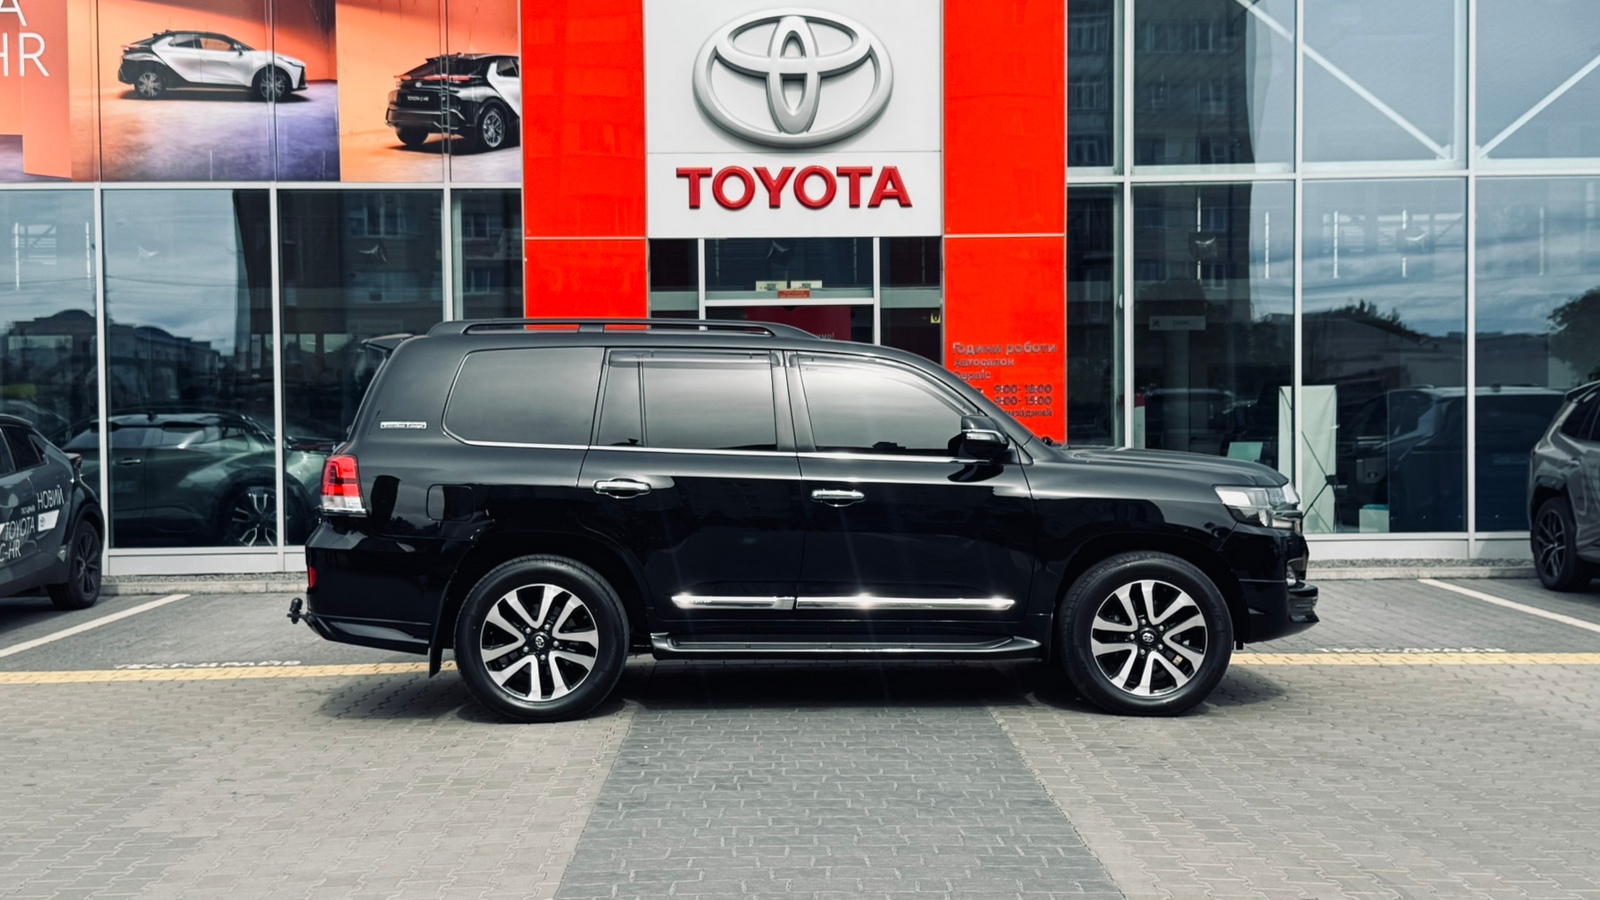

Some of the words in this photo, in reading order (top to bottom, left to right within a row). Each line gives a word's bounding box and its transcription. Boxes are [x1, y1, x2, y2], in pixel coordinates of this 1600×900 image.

[676, 165, 913, 211] TOYOTA
[952, 342, 1002, 356] Години
[1006, 341, 1057, 356] роботи
[954, 359, 1015, 368] Автосалон
[36, 484, 65, 510] НОВИЙ
[5, 516, 35, 541] TOYOTA
